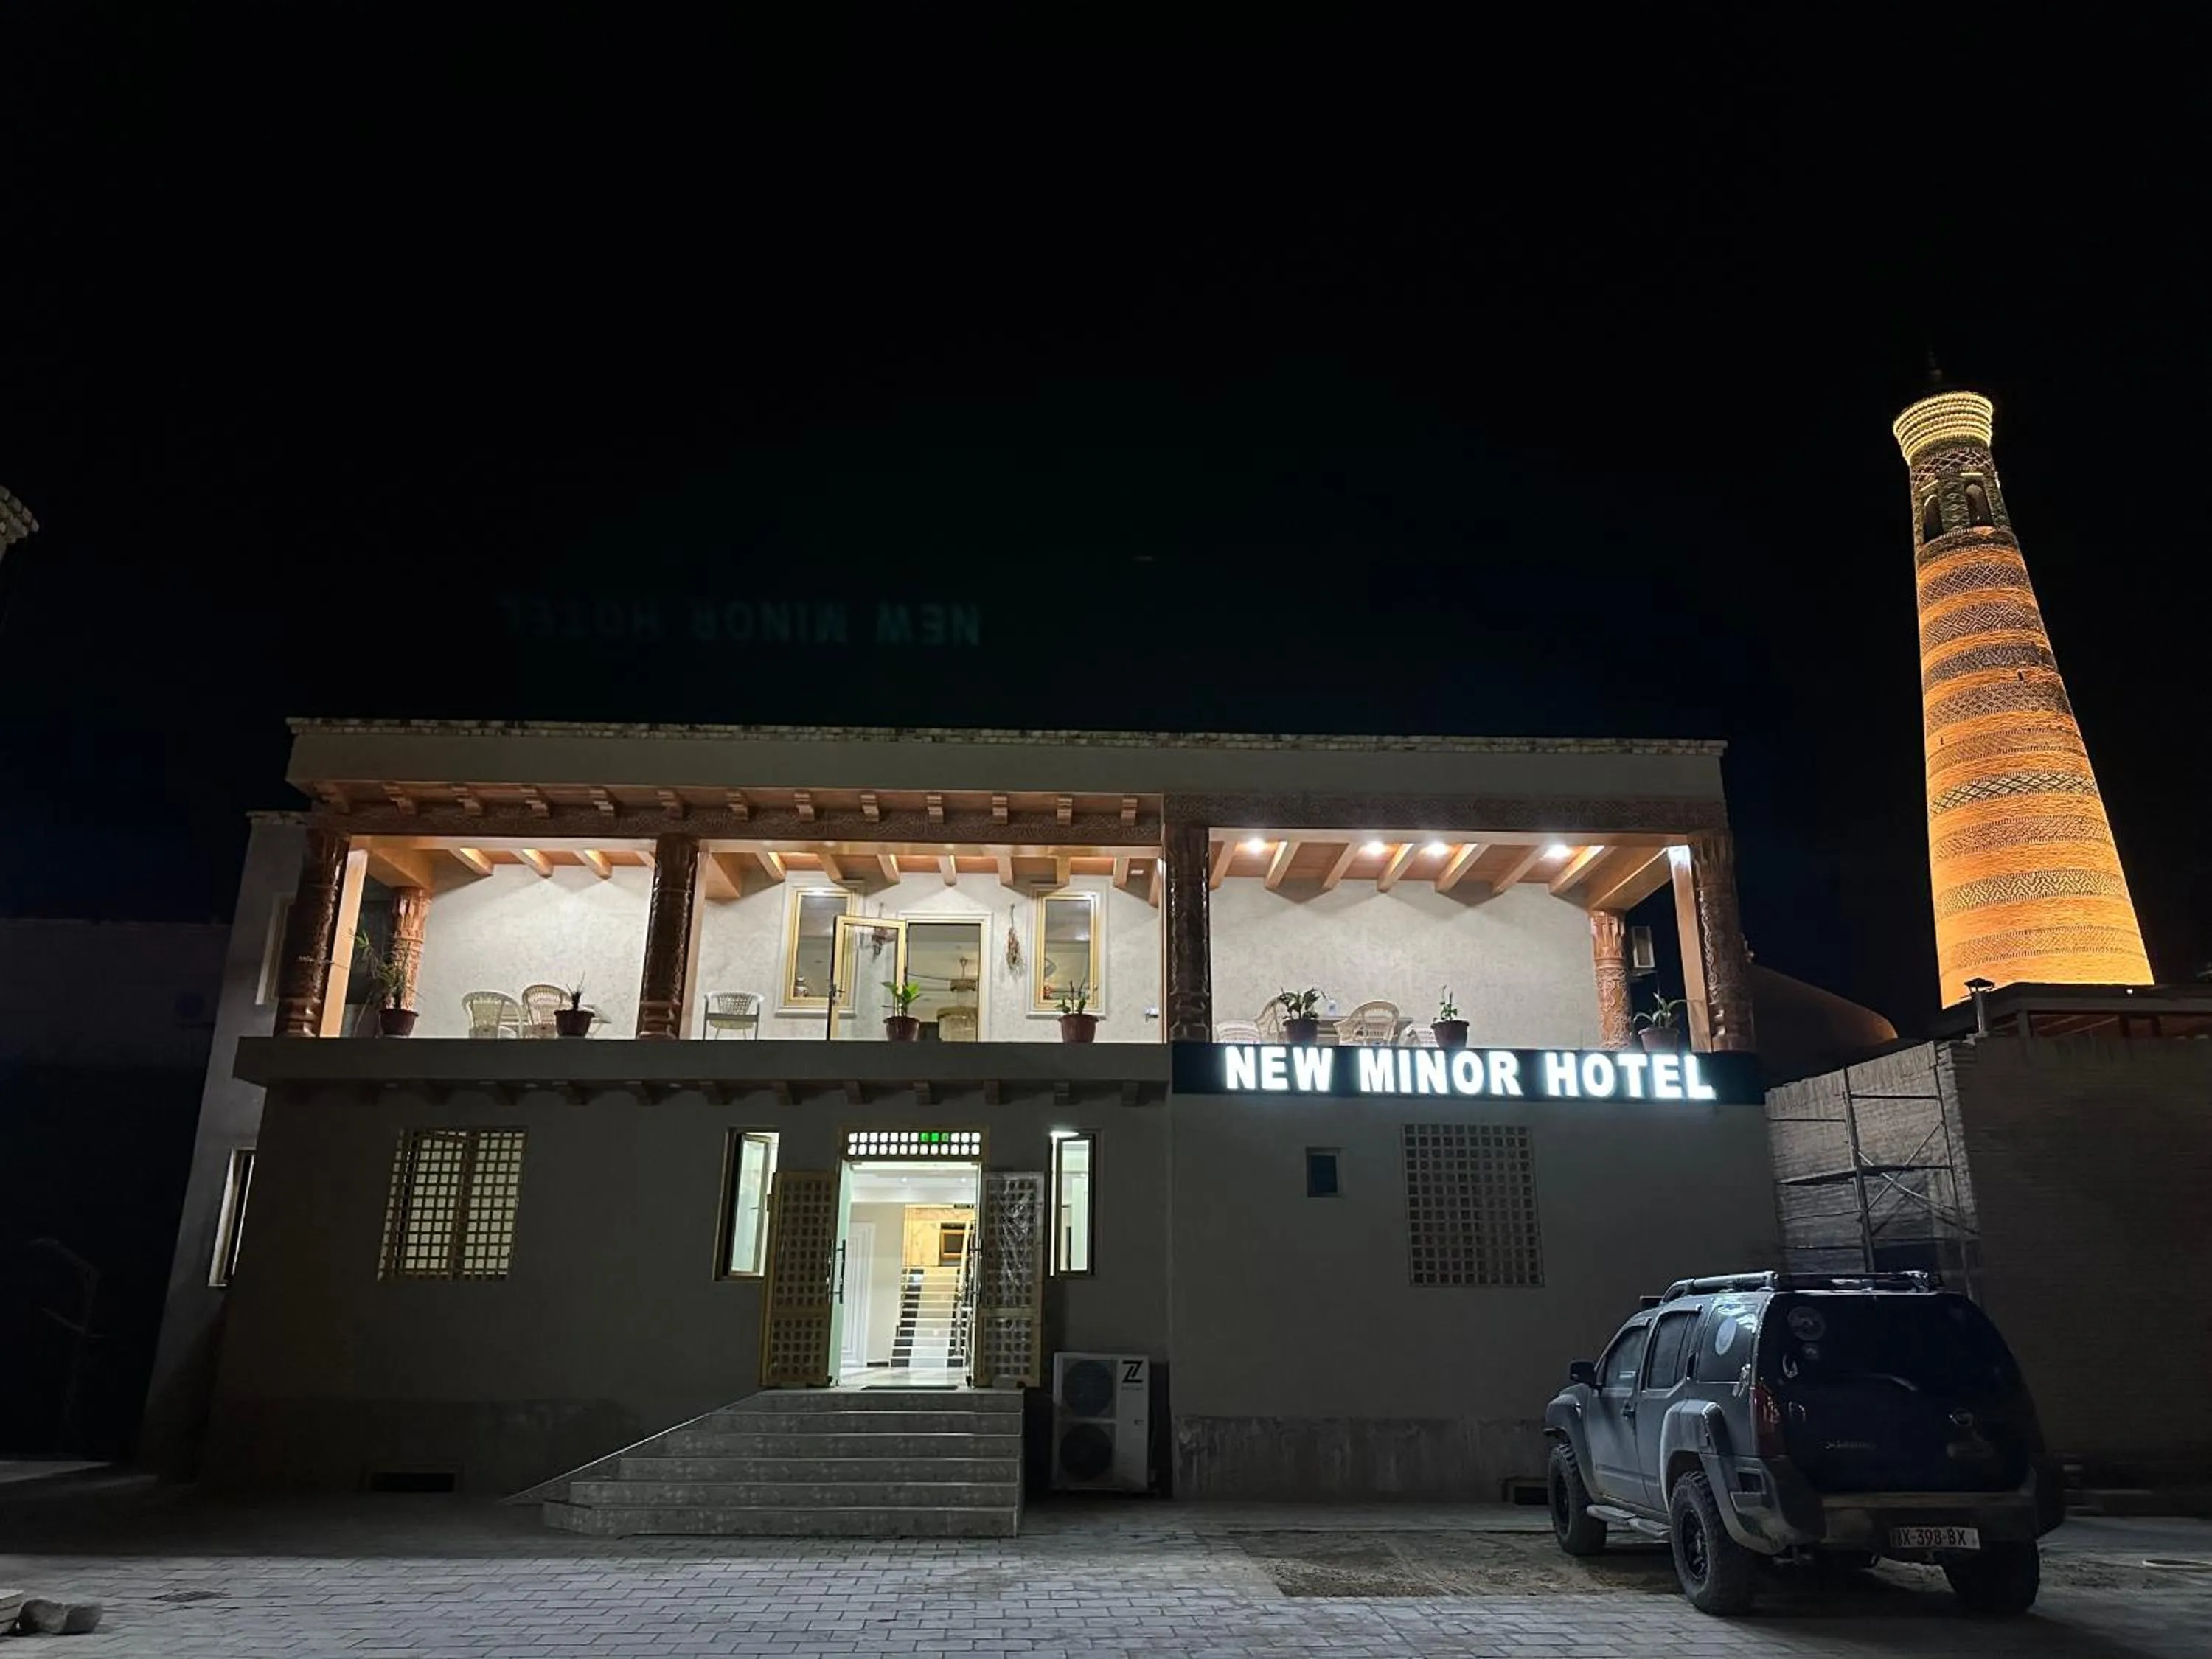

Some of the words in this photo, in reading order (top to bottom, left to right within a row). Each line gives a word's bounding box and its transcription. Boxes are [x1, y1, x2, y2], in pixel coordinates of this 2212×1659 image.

[495, 593, 664, 640] HOTEL
[686, 597, 848, 644] MINOR
[875, 599, 979, 647] NEW
[1224, 1046, 1333, 1092] NEW
[1358, 1048, 1523, 1096] MINOR
[1543, 1051, 1717, 1100] HOTEL
